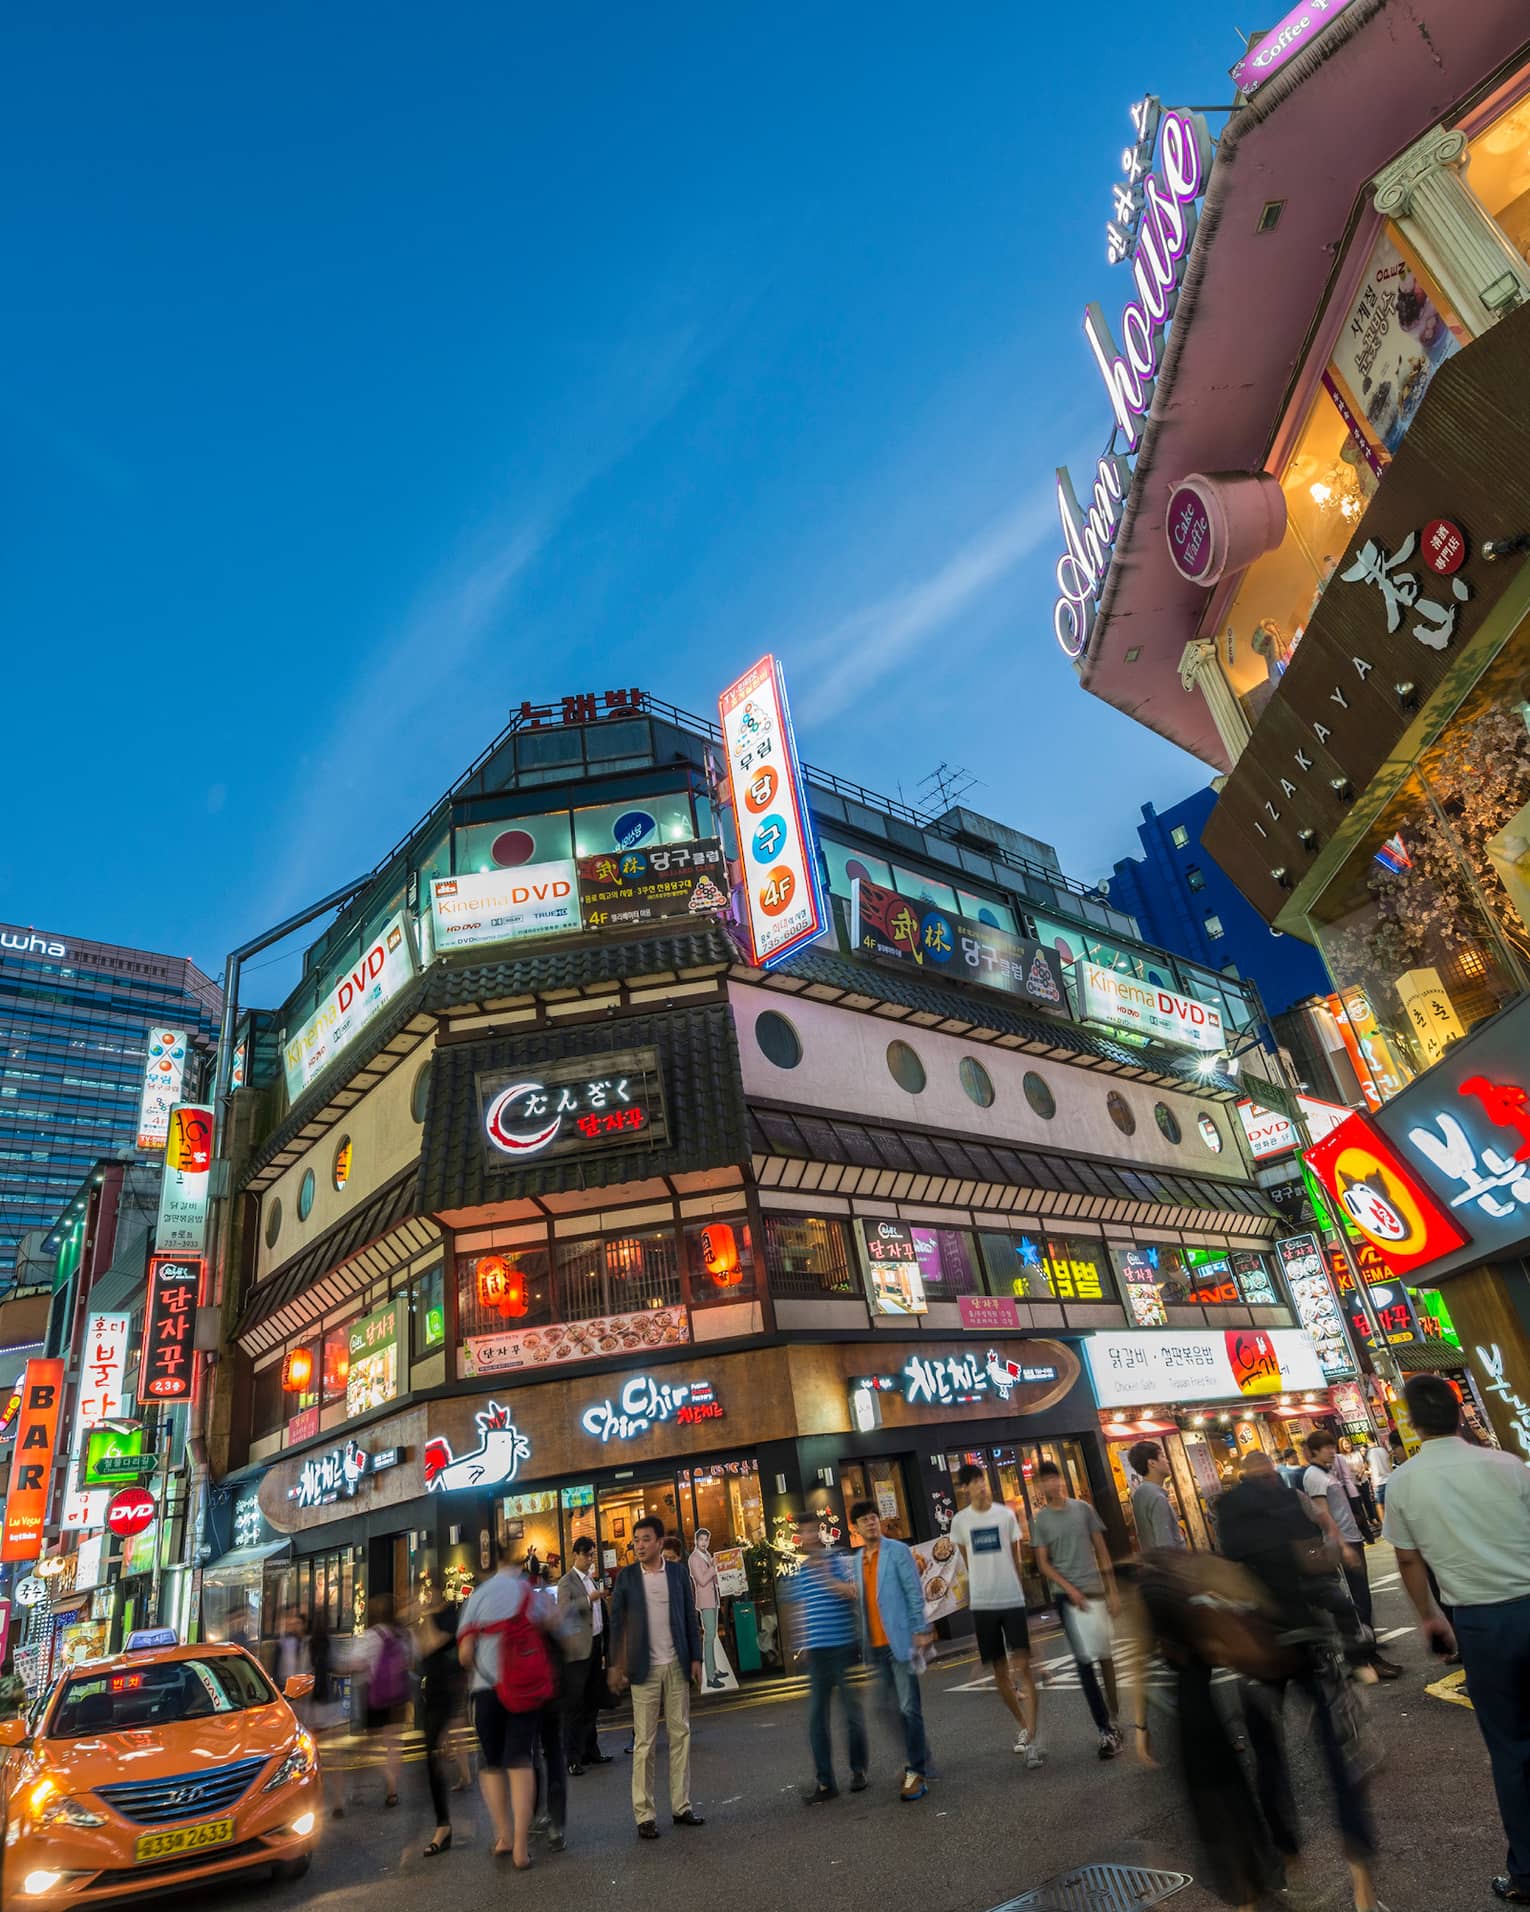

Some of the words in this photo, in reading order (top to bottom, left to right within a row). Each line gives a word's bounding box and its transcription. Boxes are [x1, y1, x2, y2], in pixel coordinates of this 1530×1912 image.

[1252, 16, 1311, 67] Coffee
[1106, 97, 1149, 264] 앤하우스
[1082, 111, 1201, 449] house
[1350, 285, 1377, 339] 사계절
[1174, 502, 1195, 545] Cake
[1182, 516, 1209, 568] Waffle
[520, 688, 641, 729] 노래방
[739, 738, 772, 770] 무림
[1253, 655, 1372, 838] IZAKAYA
[750, 774, 780, 854] 당구
[438, 895, 508, 914] Kinema
[512, 881, 571, 904] DVD
[764, 877, 792, 906] 4F
[589, 911, 608, 925] 4F
[863, 935, 876, 949] 4F
[285, 1004, 338, 1071] Kinema
[338, 946, 384, 1014] DVD
[1089, 967, 1155, 1008] Kinema
[1158, 992, 1205, 1025] DVD
[577, 1107, 644, 1137] 단자꾸
[1248, 1120, 1289, 1141] DVD
[869, 1241, 914, 1260] 단자꾸
[1337, 1265, 1395, 1289] KIEMA
[155, 1286, 192, 1375] 단자꾸
[483, 1344, 520, 1359] 단자꾸
[1108, 1347, 1149, 1369] 닭갈비
[622, 1376, 688, 1420] Chir
[582, 1399, 649, 1441] Chir
[17, 1386, 55, 1490] BAR
[21, 1516, 41, 1528] Vegas
[110, 1503, 154, 1522] DVD
[20, 1583, 42, 1599] 국수
[112, 1676, 140, 1692] 빈차
[187, 1823, 229, 1846] 2633
